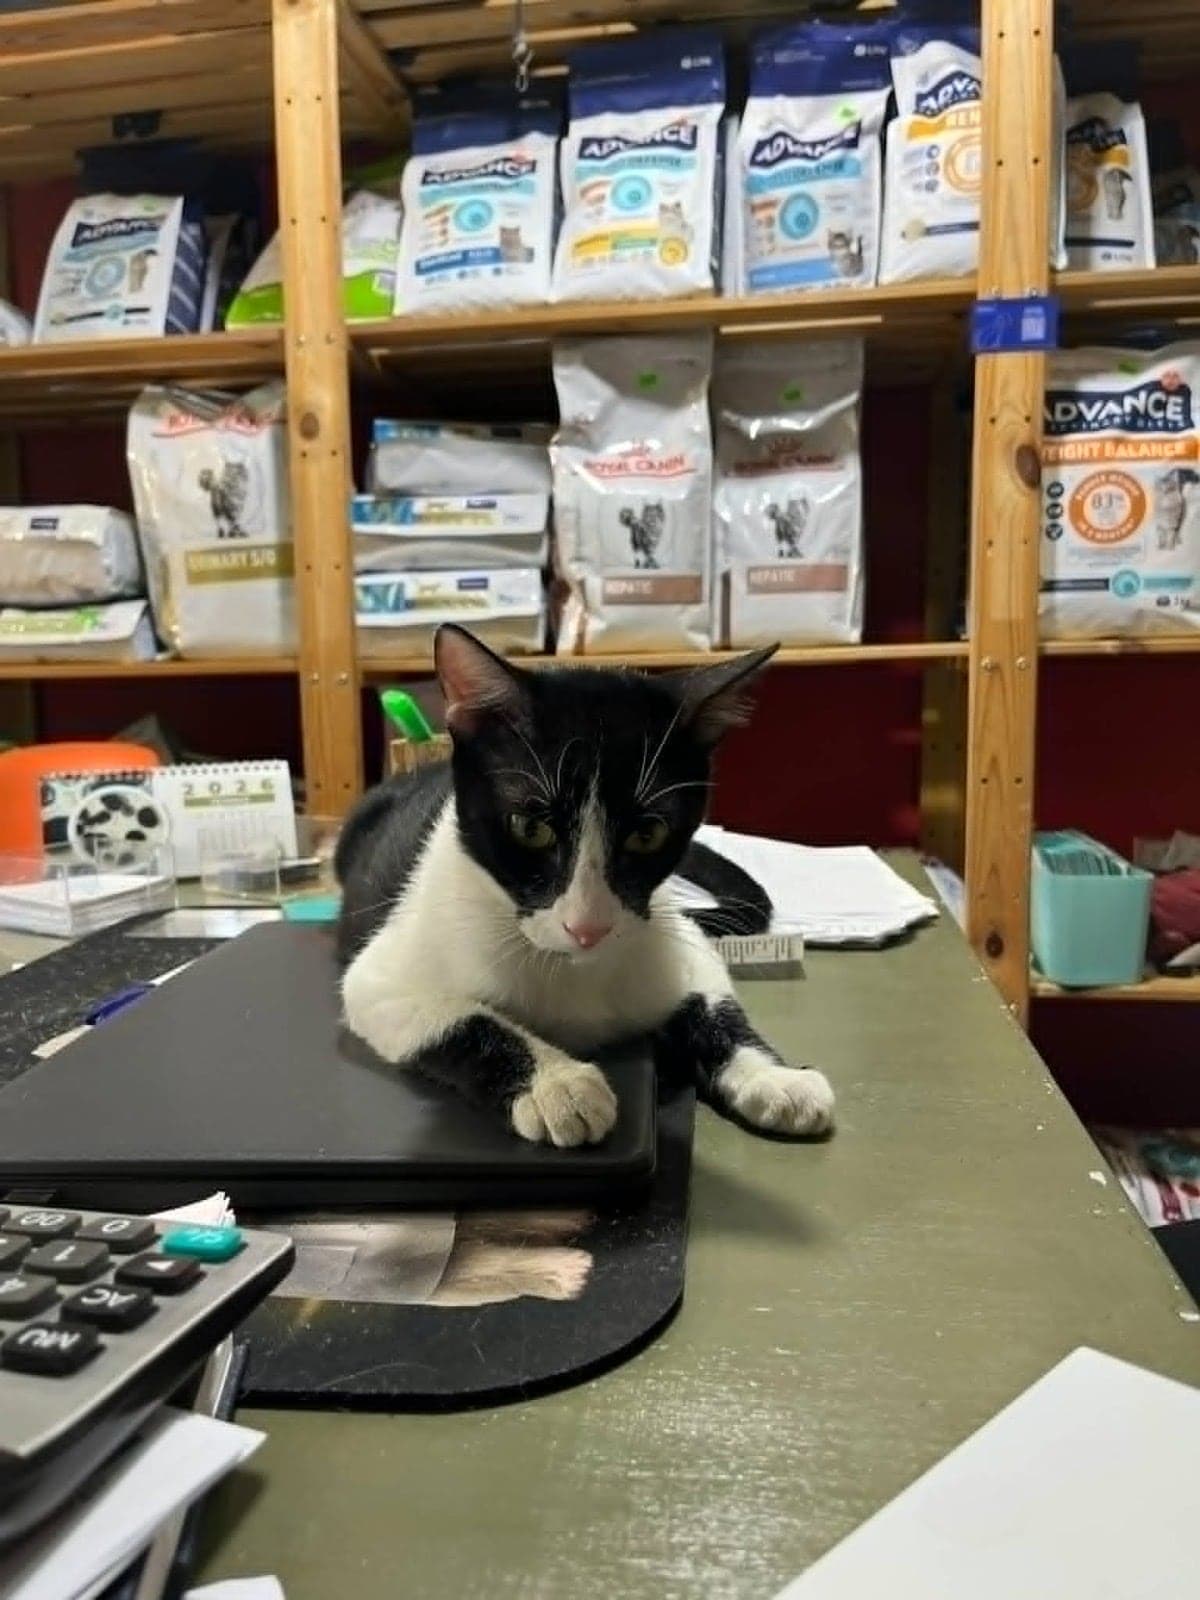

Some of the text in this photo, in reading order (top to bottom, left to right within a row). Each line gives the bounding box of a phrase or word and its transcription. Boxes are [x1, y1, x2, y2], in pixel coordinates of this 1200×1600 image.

[1103, 440, 1186, 459] BALANCE
[750, 568, 795, 584] HEPATIC
[606, 580, 654, 595] HEPATIC
[101, 1219, 131, 1233] 0
[53, 1245, 76, 1261] 1
[81, 1288, 137, 1308] AC
